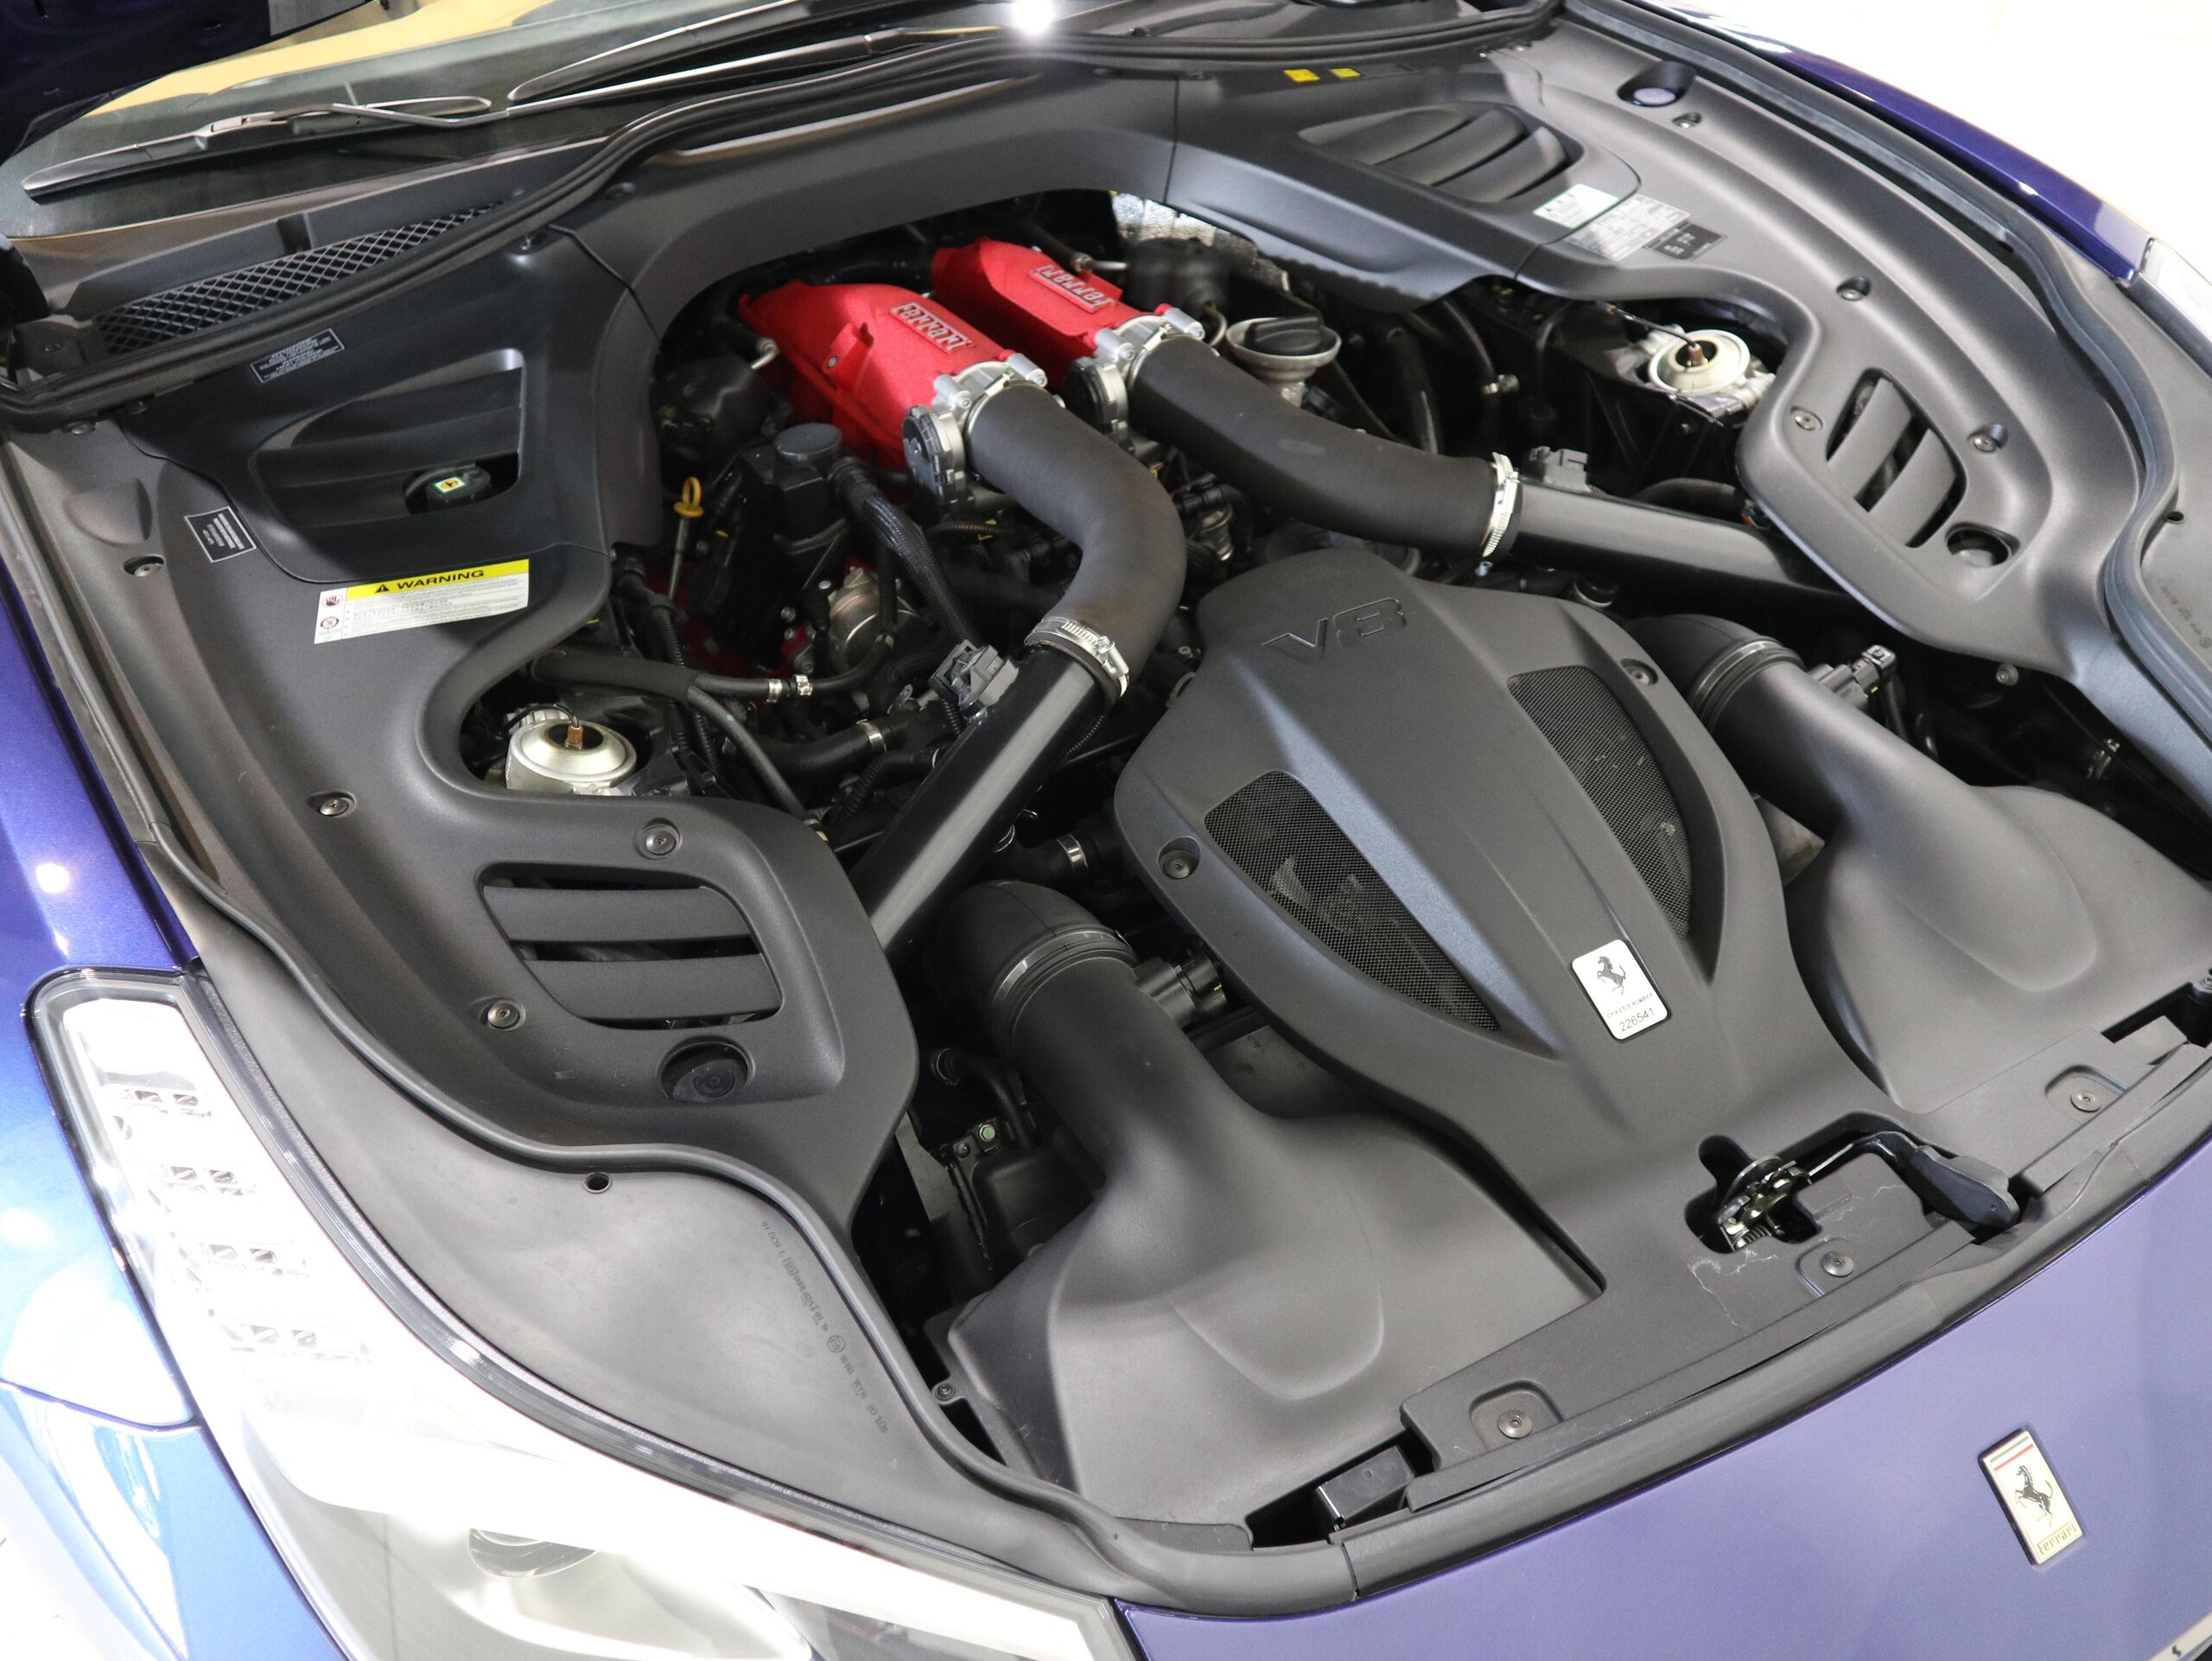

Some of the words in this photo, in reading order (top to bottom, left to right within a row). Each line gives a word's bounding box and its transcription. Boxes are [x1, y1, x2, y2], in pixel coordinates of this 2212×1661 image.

[1033, 264, 1115, 308] Ferrari
[892, 302, 972, 350] Ferrari
[397, 570, 484, 589] WARNING
[1261, 597, 1408, 662] V8
[1607, 1002, 1631, 1019] CHASSIS
[1632, 992, 1654, 1007] NUMBER
[1619, 1007, 1654, 1032] 226541
[2037, 1521, 2077, 1555] Ferrari
